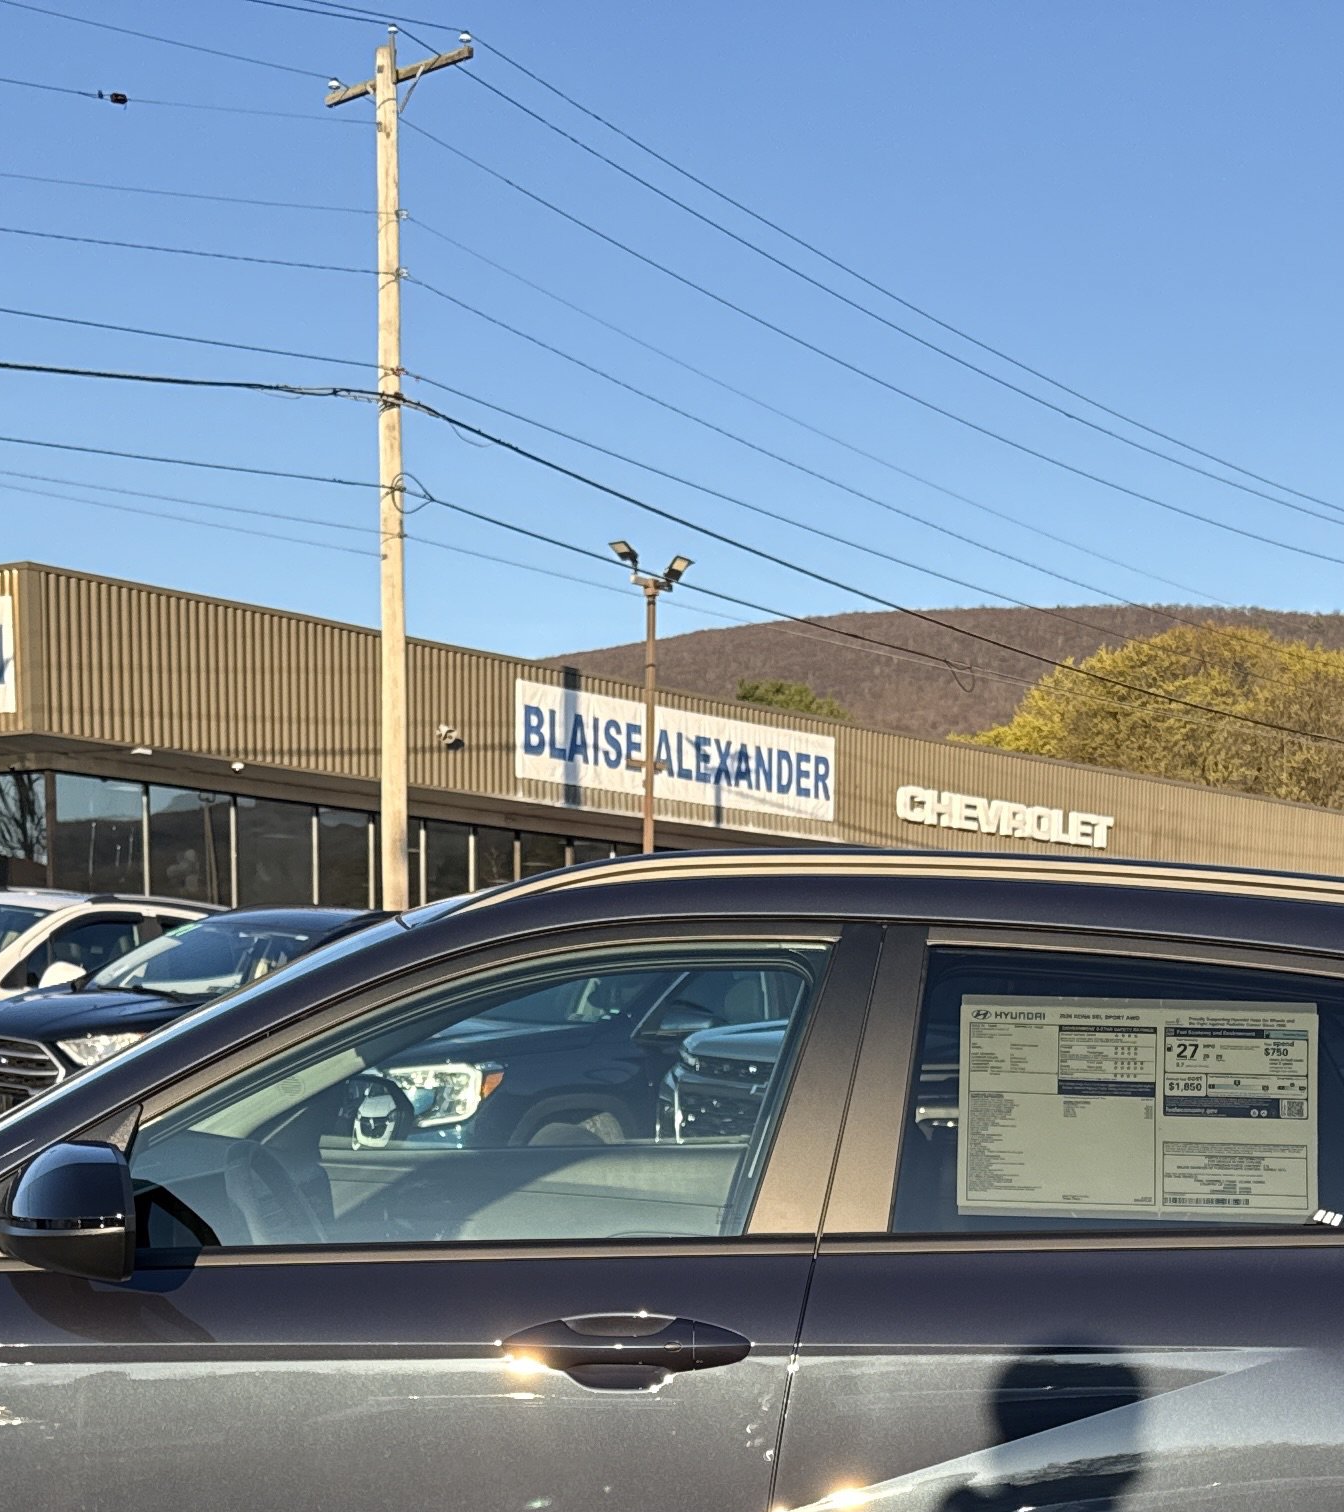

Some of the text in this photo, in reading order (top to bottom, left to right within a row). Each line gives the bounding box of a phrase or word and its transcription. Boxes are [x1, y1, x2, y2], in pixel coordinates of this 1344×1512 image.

[523, 703, 832, 801] BLAISE ALEXANDER
[895, 785, 1114, 849] CHEVROLET
[994, 1011, 1046, 1020] HYUNDAI
[1176, 1044, 1199, 1059] 27
[1264, 1048, 1288, 1057] $750
[1168, 1082, 1202, 1092] $1,850
